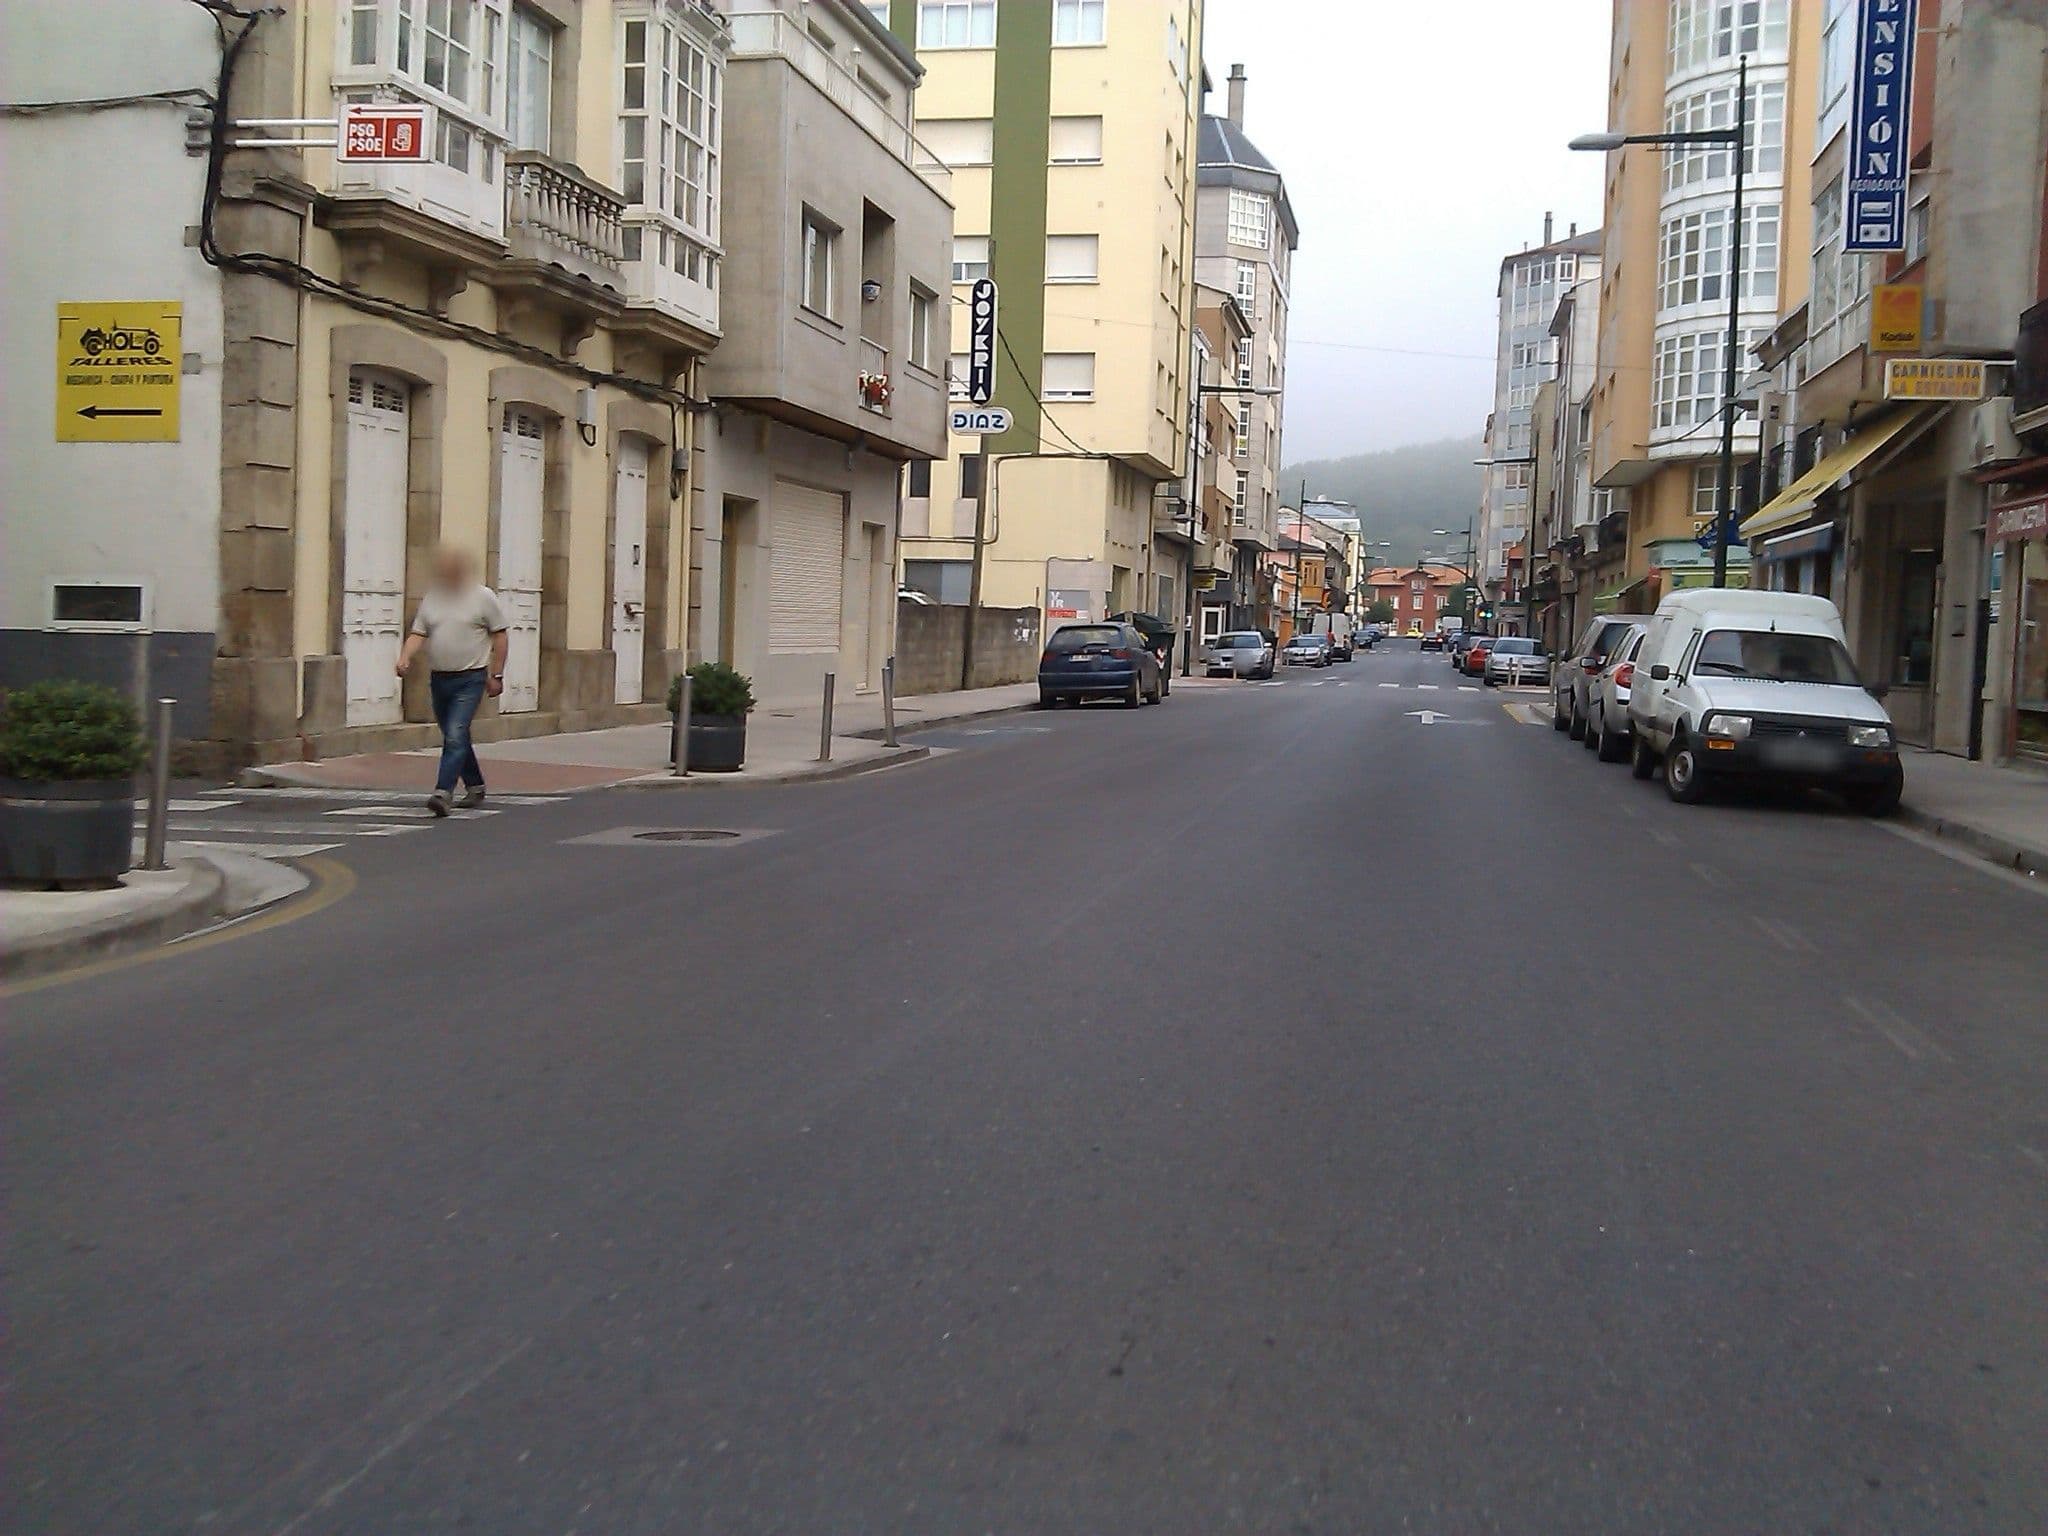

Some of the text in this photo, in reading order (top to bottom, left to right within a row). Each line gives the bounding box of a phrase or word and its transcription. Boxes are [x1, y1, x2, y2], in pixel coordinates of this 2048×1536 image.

[349, 123, 375, 137] PSG
[348, 138, 382, 152] PSOE
[1851, 179, 1906, 192] RESIDENCIA
[973, 283, 992, 401] JOYERIA
[69, 356, 173, 366] TALLERES
[1892, 364, 1981, 379] CARNICERIA
[953, 414, 1005, 429] DIAZ
